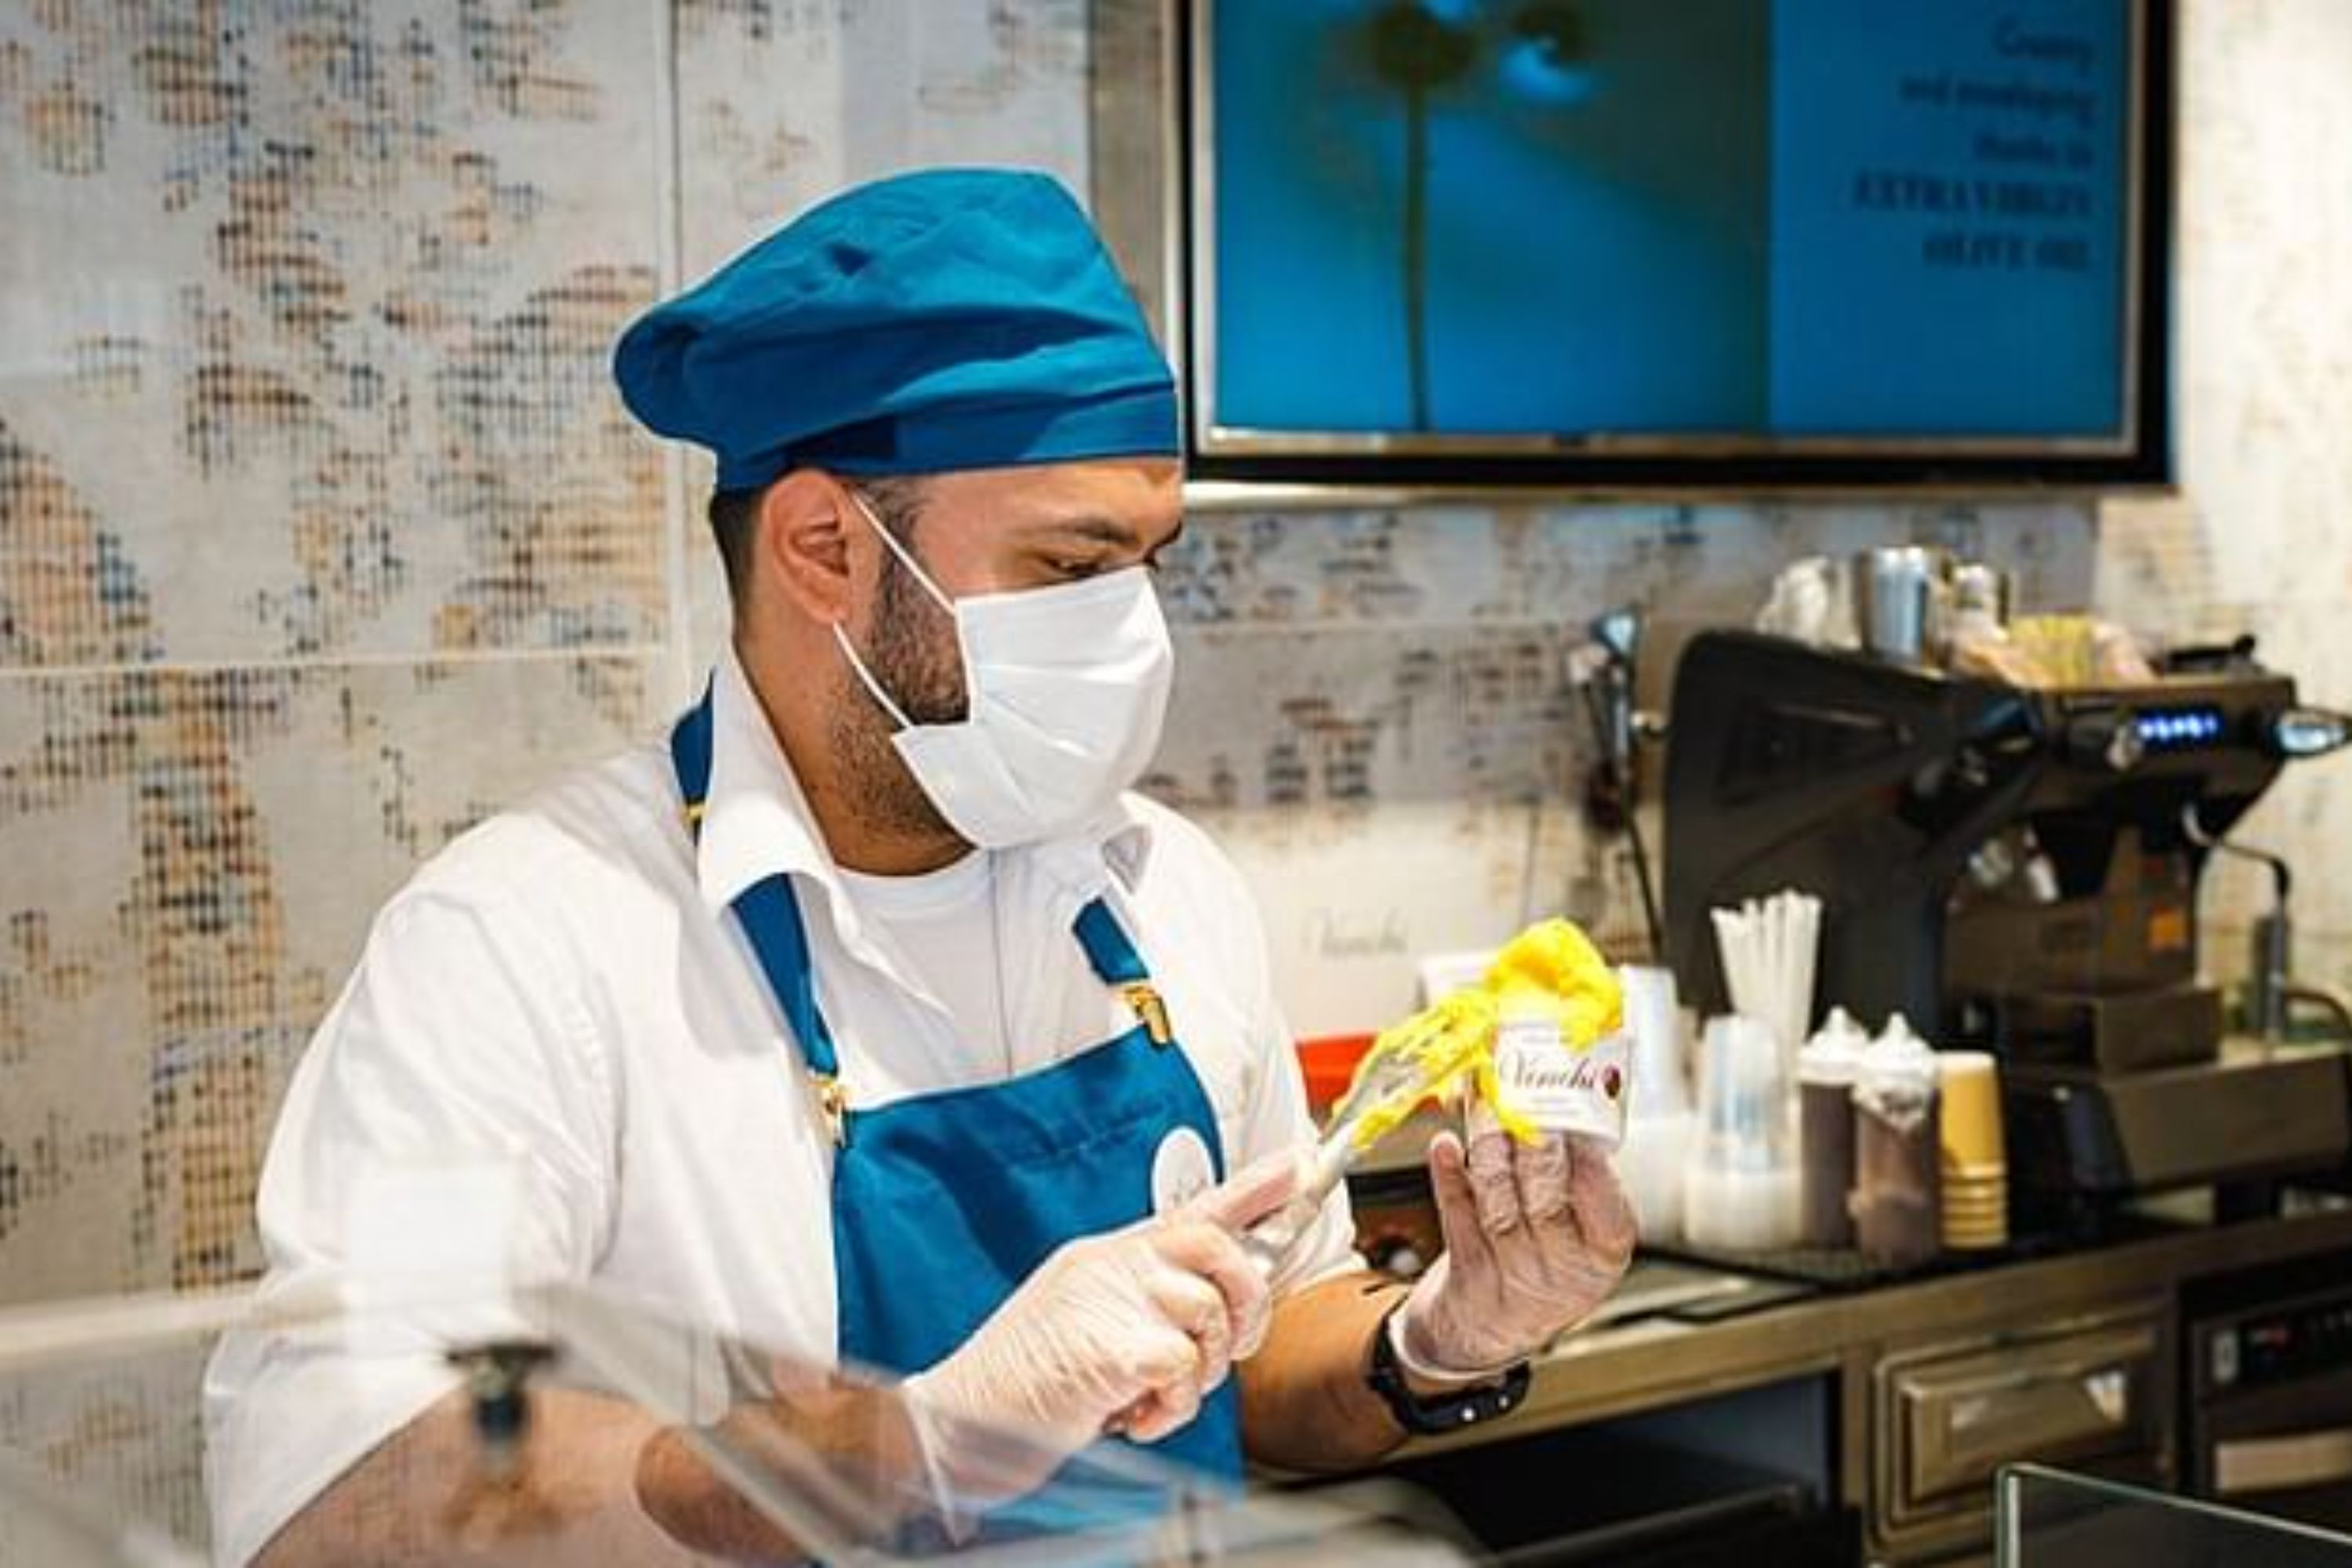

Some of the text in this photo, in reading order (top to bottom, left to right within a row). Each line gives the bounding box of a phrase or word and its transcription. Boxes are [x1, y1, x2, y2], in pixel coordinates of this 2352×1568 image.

[1853, 168, 2091, 216] EXTRA VIRGIN
[1923, 229, 2025, 270] OLIVE
